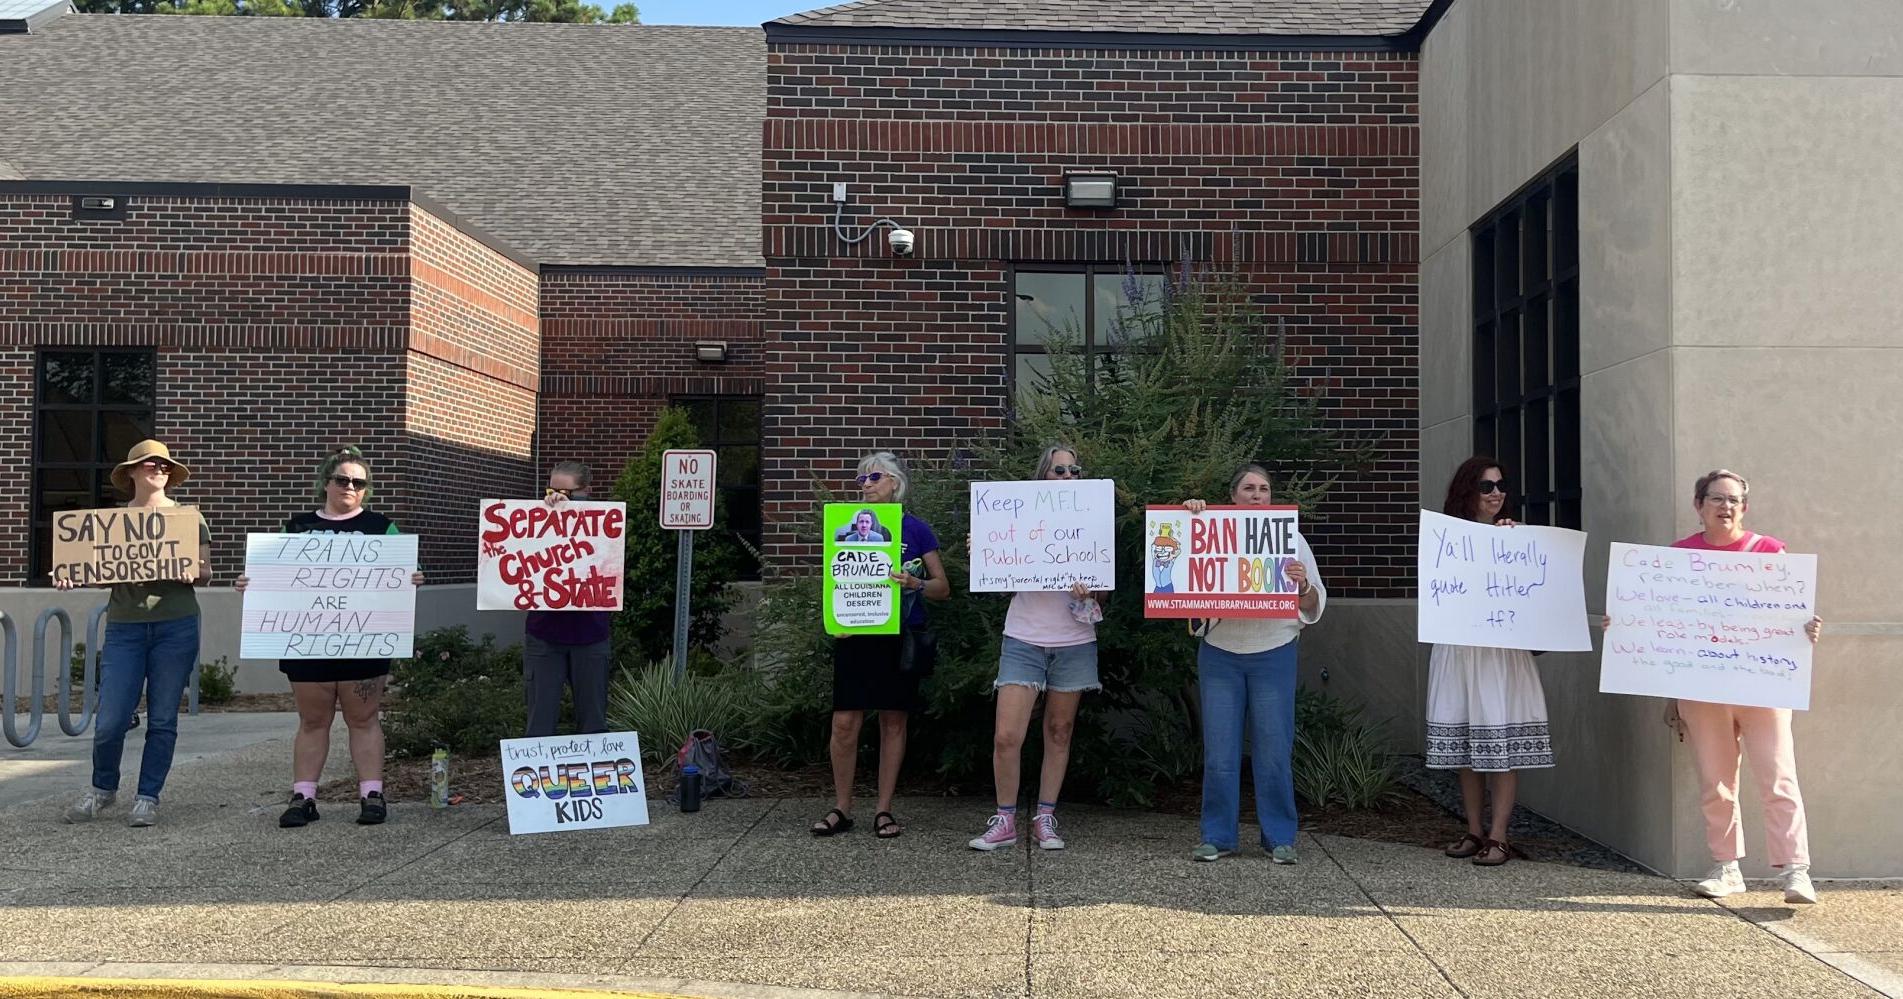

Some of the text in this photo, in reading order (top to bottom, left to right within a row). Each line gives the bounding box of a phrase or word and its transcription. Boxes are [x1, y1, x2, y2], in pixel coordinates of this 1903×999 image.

[679, 459, 698, 474] NO
[671, 480, 704, 488] SKATE
[666, 491, 708, 500] BOARDING
[680, 502, 691, 511] OR
[976, 489, 1024, 518] Keep
[57, 512, 166, 544] SAY NO
[670, 514, 701, 523] SKATING
[988, 519, 1086, 542] out of our
[1191, 517, 1296, 554] BAN HATE
[93, 540, 180, 561] TO GOVT
[277, 536, 383, 564] TRANS
[483, 542, 507, 558] the
[837, 551, 880, 562] CADE
[982, 541, 1111, 567] Public Schools
[1623, 549, 1674, 568] Cade
[53, 557, 193, 584] CENSORSHIP
[499, 537, 594, 586] Church
[832, 563, 893, 577] BRUMLEY
[290, 567, 406, 589] RIGHTS
[1188, 557, 1298, 593] NOT BOOKS
[514, 579, 543, 610] &
[1430, 572, 1535, 606] quote Hitler
[1697, 594, 1718, 603] all
[311, 596, 348, 610] ARE
[1147, 600, 1296, 610] WWW.STTAMMANYLIBRARYALLIANCE.ORG
[260, 611, 372, 632] HUMAN
[284, 633, 399, 657] RIGHTS
[1697, 648, 1740, 660] about
[508, 736, 624, 761] trust, protect, love
[511, 758, 638, 800] QUEER
[554, 797, 604, 824] KIDS
